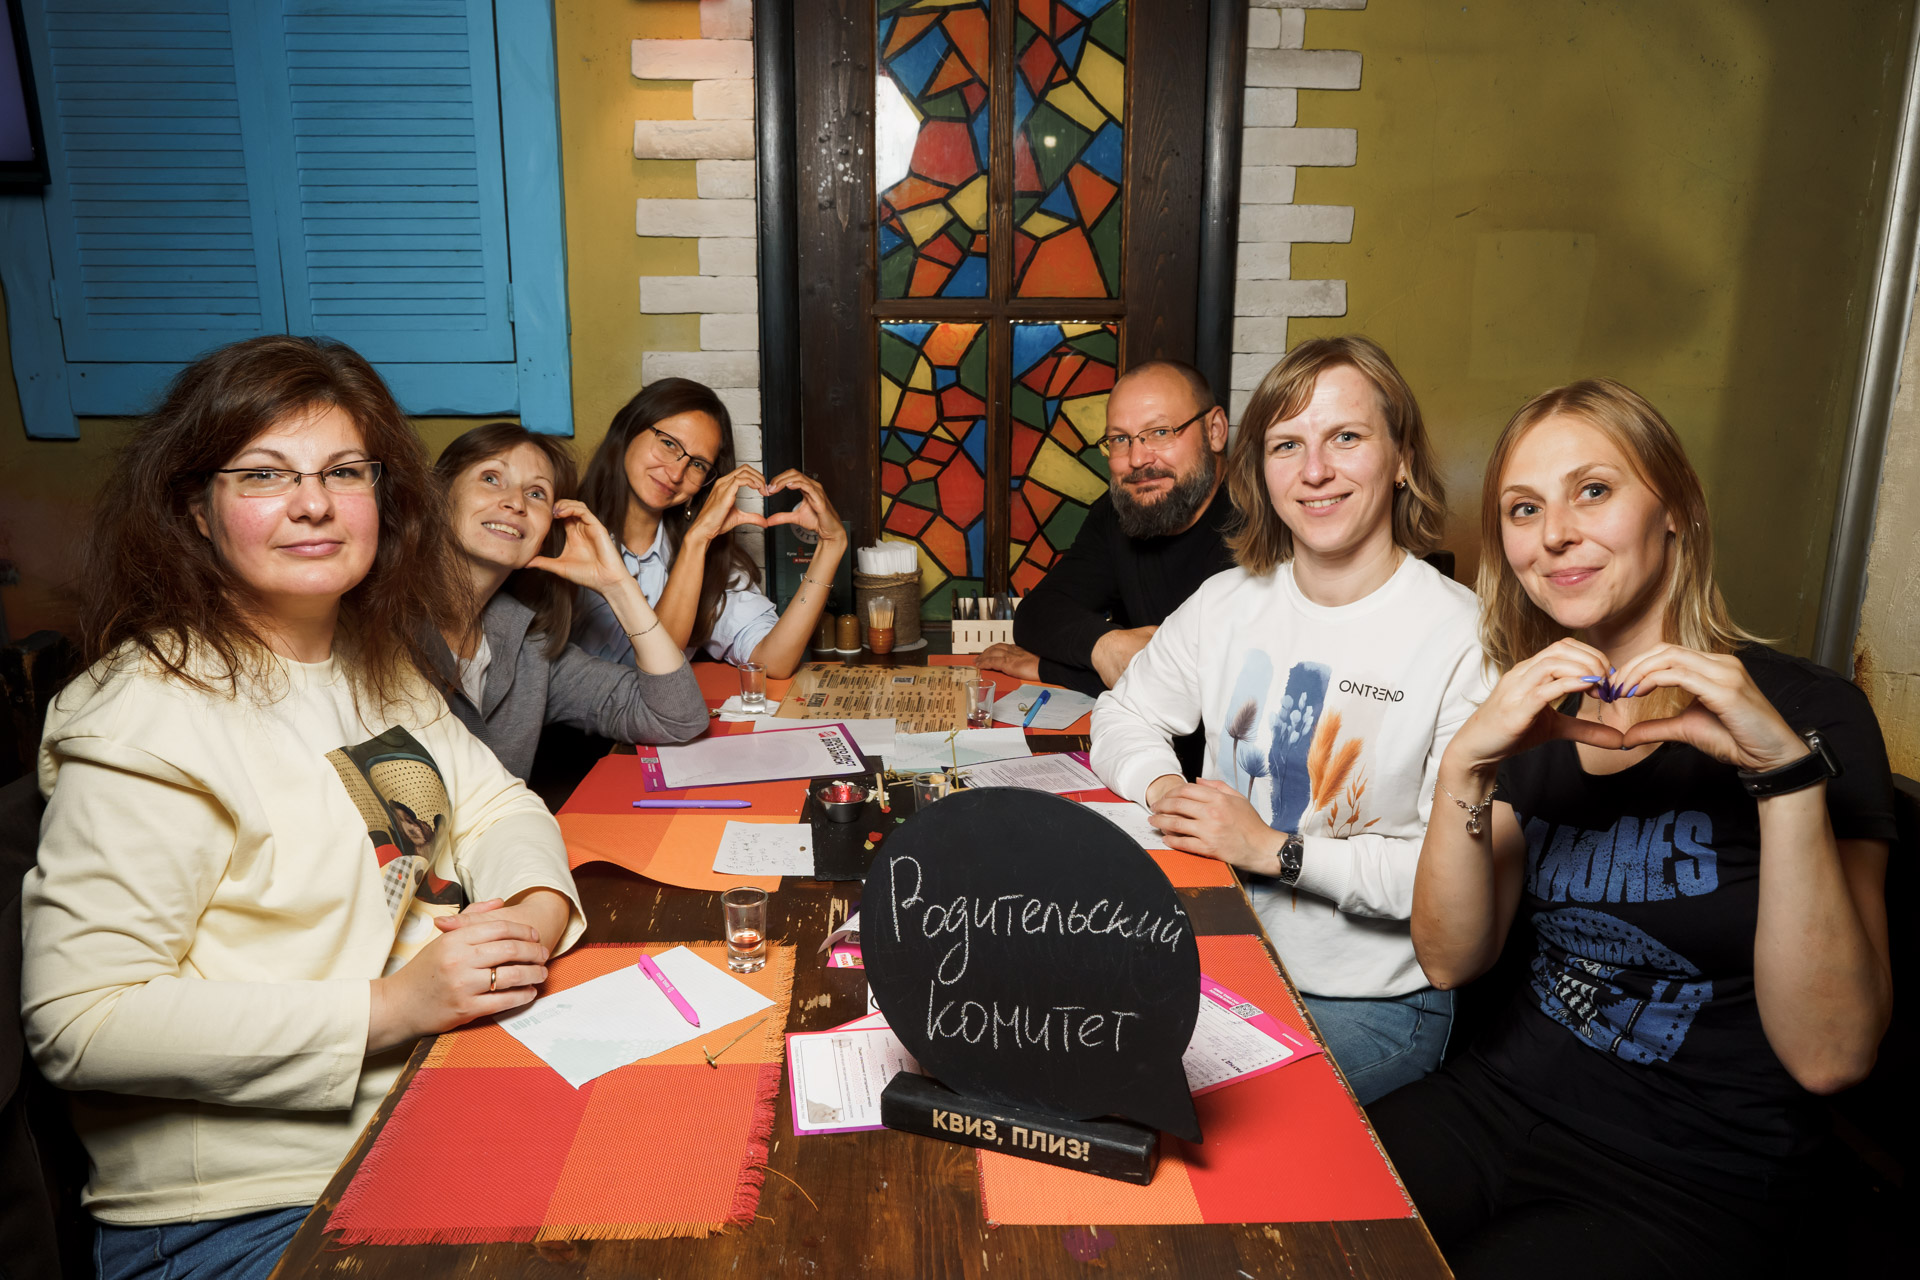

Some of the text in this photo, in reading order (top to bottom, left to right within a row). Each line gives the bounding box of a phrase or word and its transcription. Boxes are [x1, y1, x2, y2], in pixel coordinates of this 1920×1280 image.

[1338, 679, 1405, 703] ONTREND
[826, 746, 845, 766] ЗАПИСИ
[830, 737, 849, 754] ПРОСТО
[1514, 809, 1719, 903] AMONES
[889, 855, 1185, 985] Родительский
[931, 1108, 1091, 1162] КВИЗ, ПЛИЗ!
